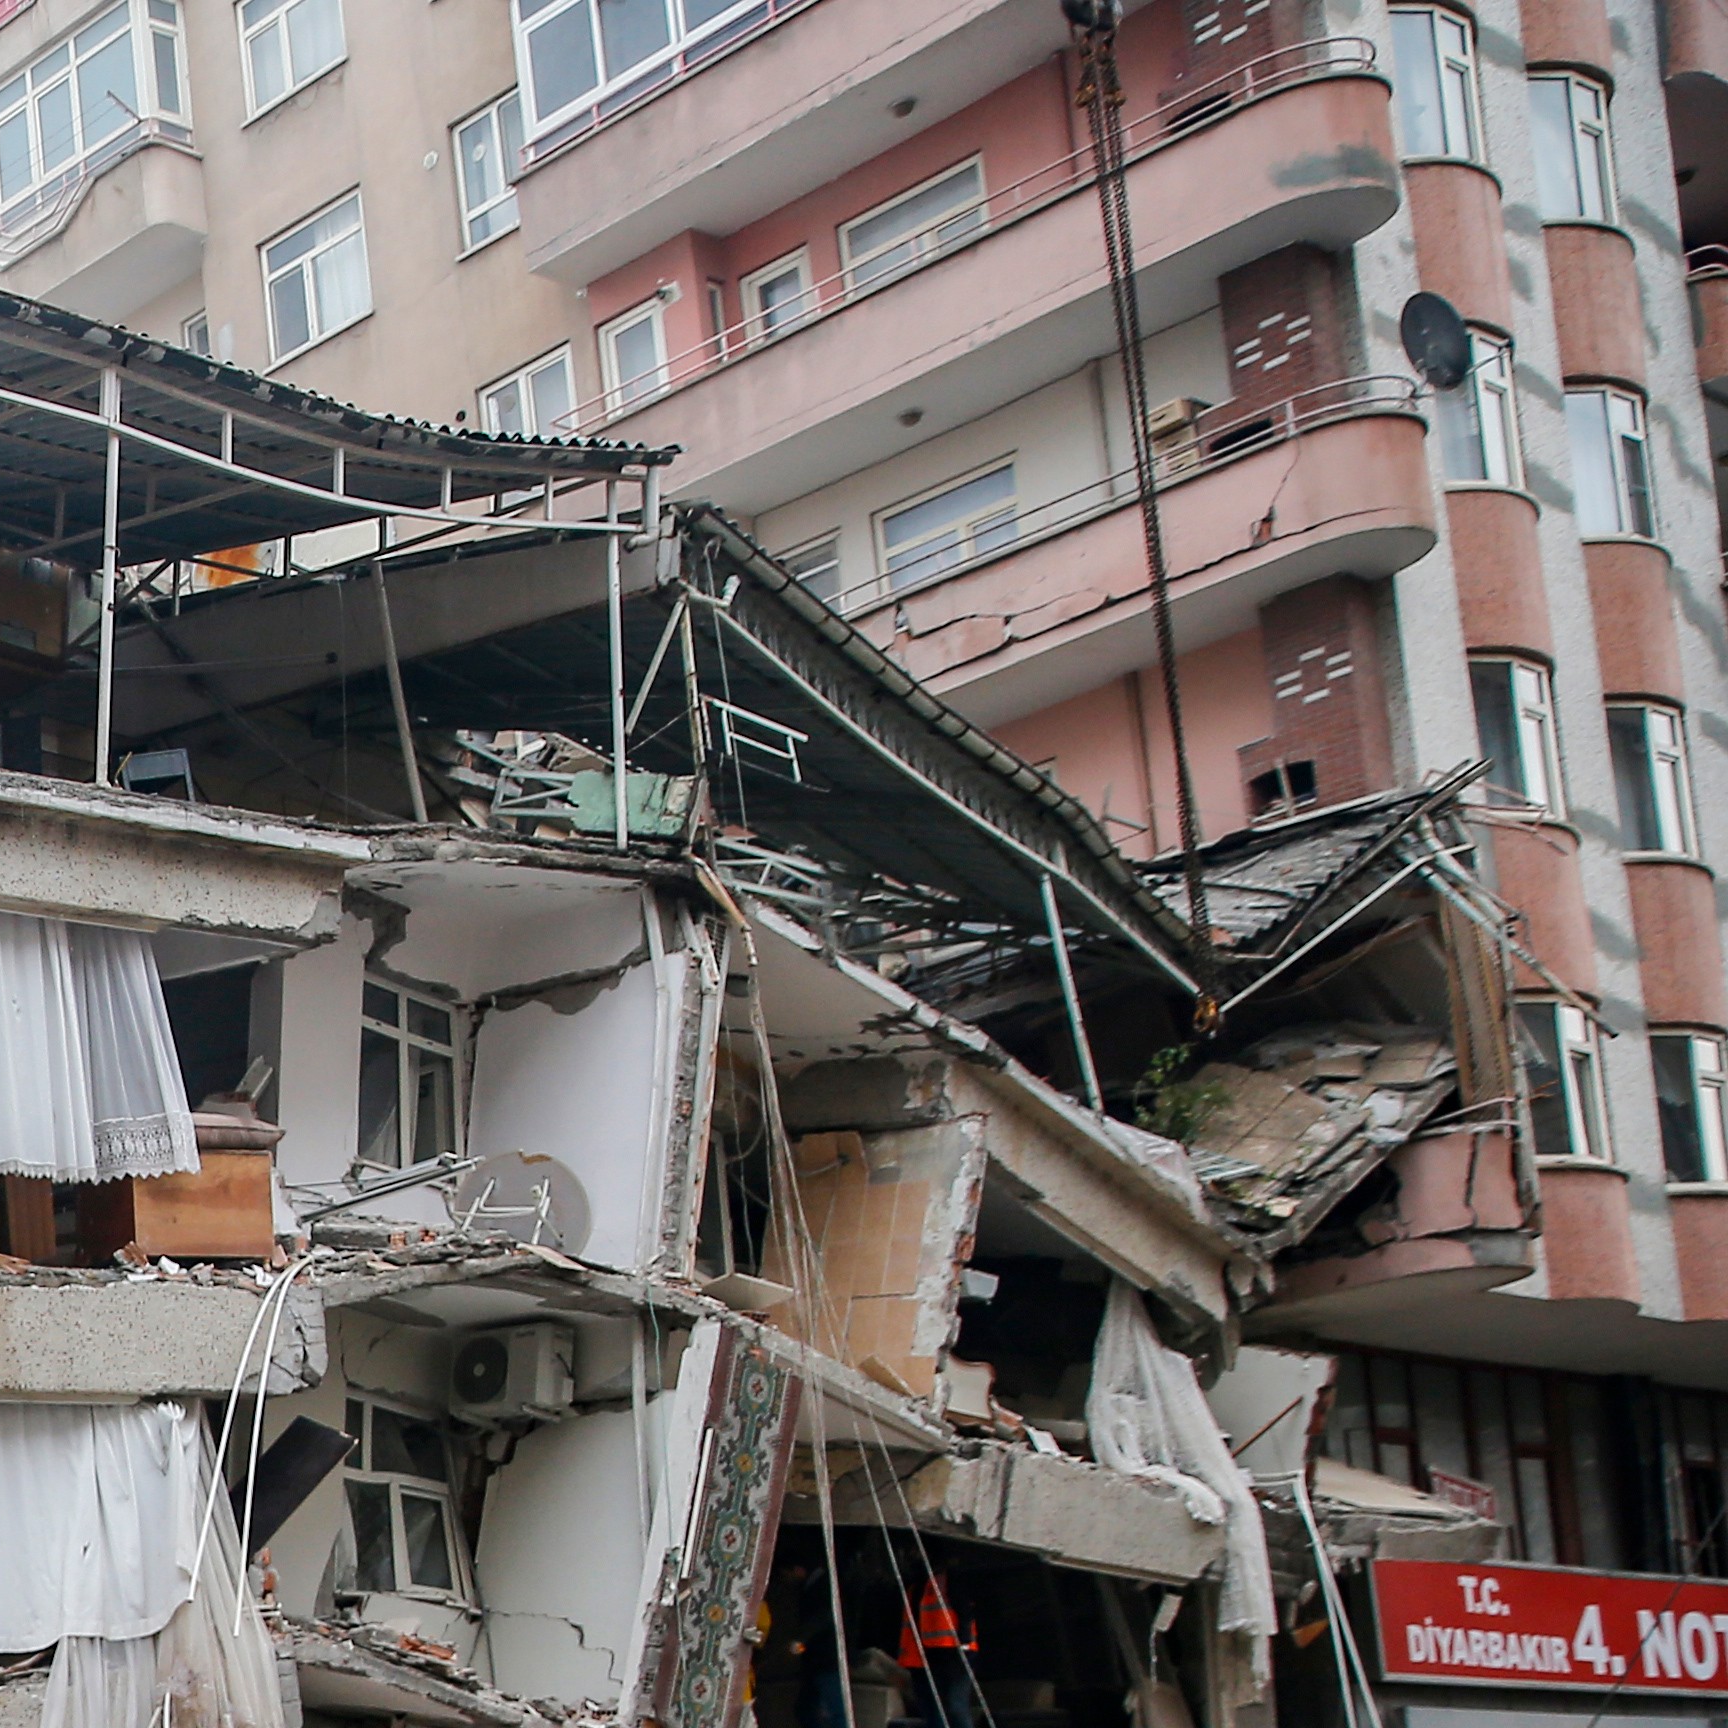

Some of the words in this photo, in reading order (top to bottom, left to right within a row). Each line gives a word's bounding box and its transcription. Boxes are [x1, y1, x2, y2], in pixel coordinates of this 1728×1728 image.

[1458, 1575, 1510, 1616] T.C.
[1406, 1616, 1572, 1674] DİYARBAKIR
[1573, 1604, 1627, 1676] 4.
